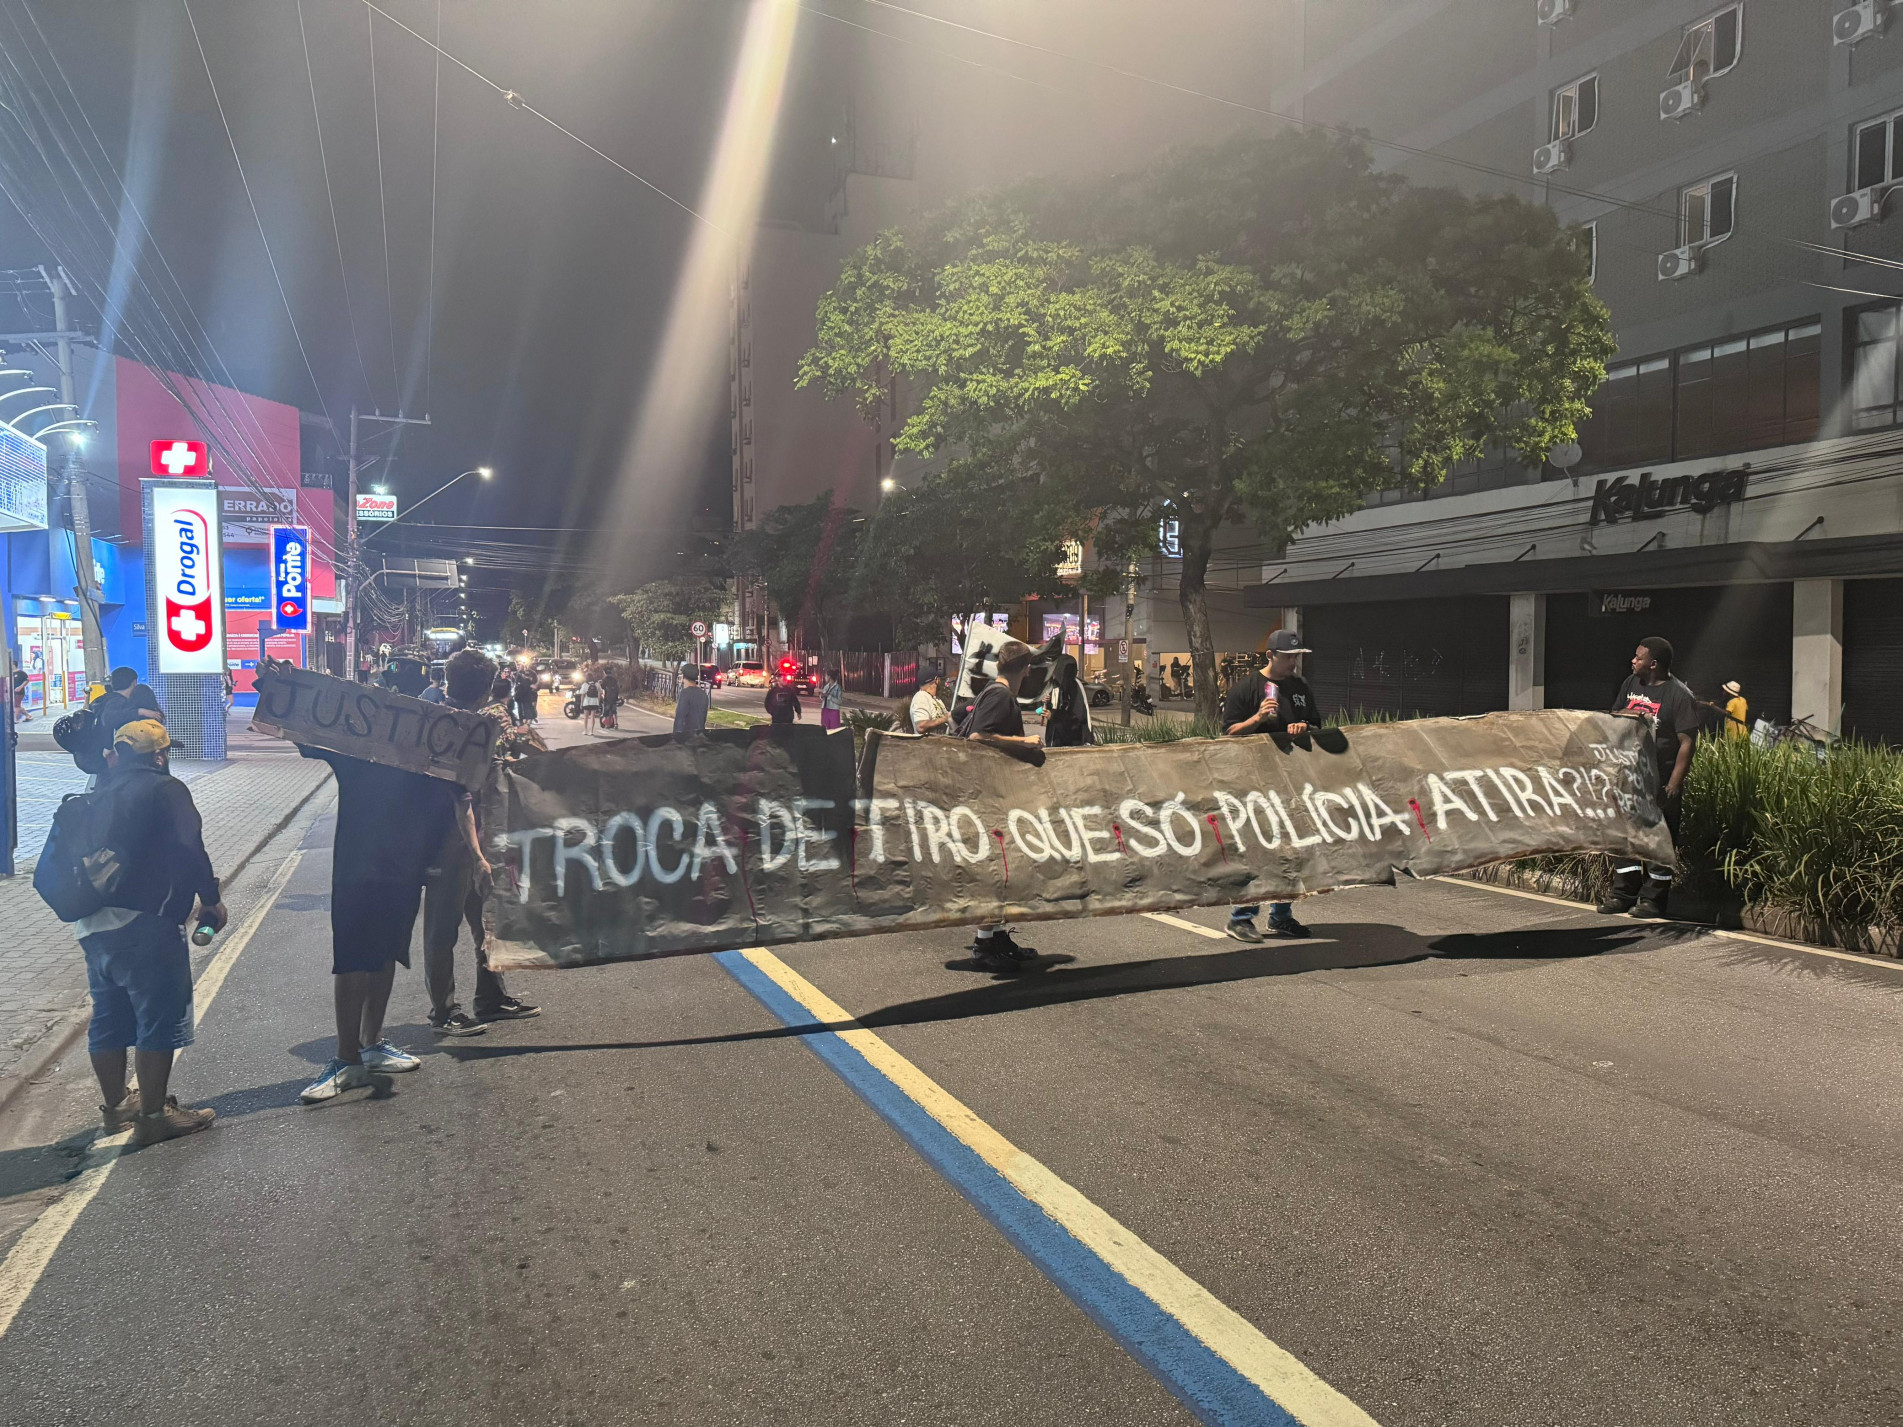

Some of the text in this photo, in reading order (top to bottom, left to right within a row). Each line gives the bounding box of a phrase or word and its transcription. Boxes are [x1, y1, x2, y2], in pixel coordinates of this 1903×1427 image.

[174, 519, 200, 596] Drogal
[282, 541, 302, 598] Ponte
[693, 624, 704, 632] 60
[493, 800, 739, 904] TROCA
[757, 797, 841, 873] DE
[850, 798, 991, 863] TIRO
[1008, 805, 1122, 863] QUE
[1119, 790, 1202, 857] SÓ
[1213, 782, 1412, 853] POLÍCIA
